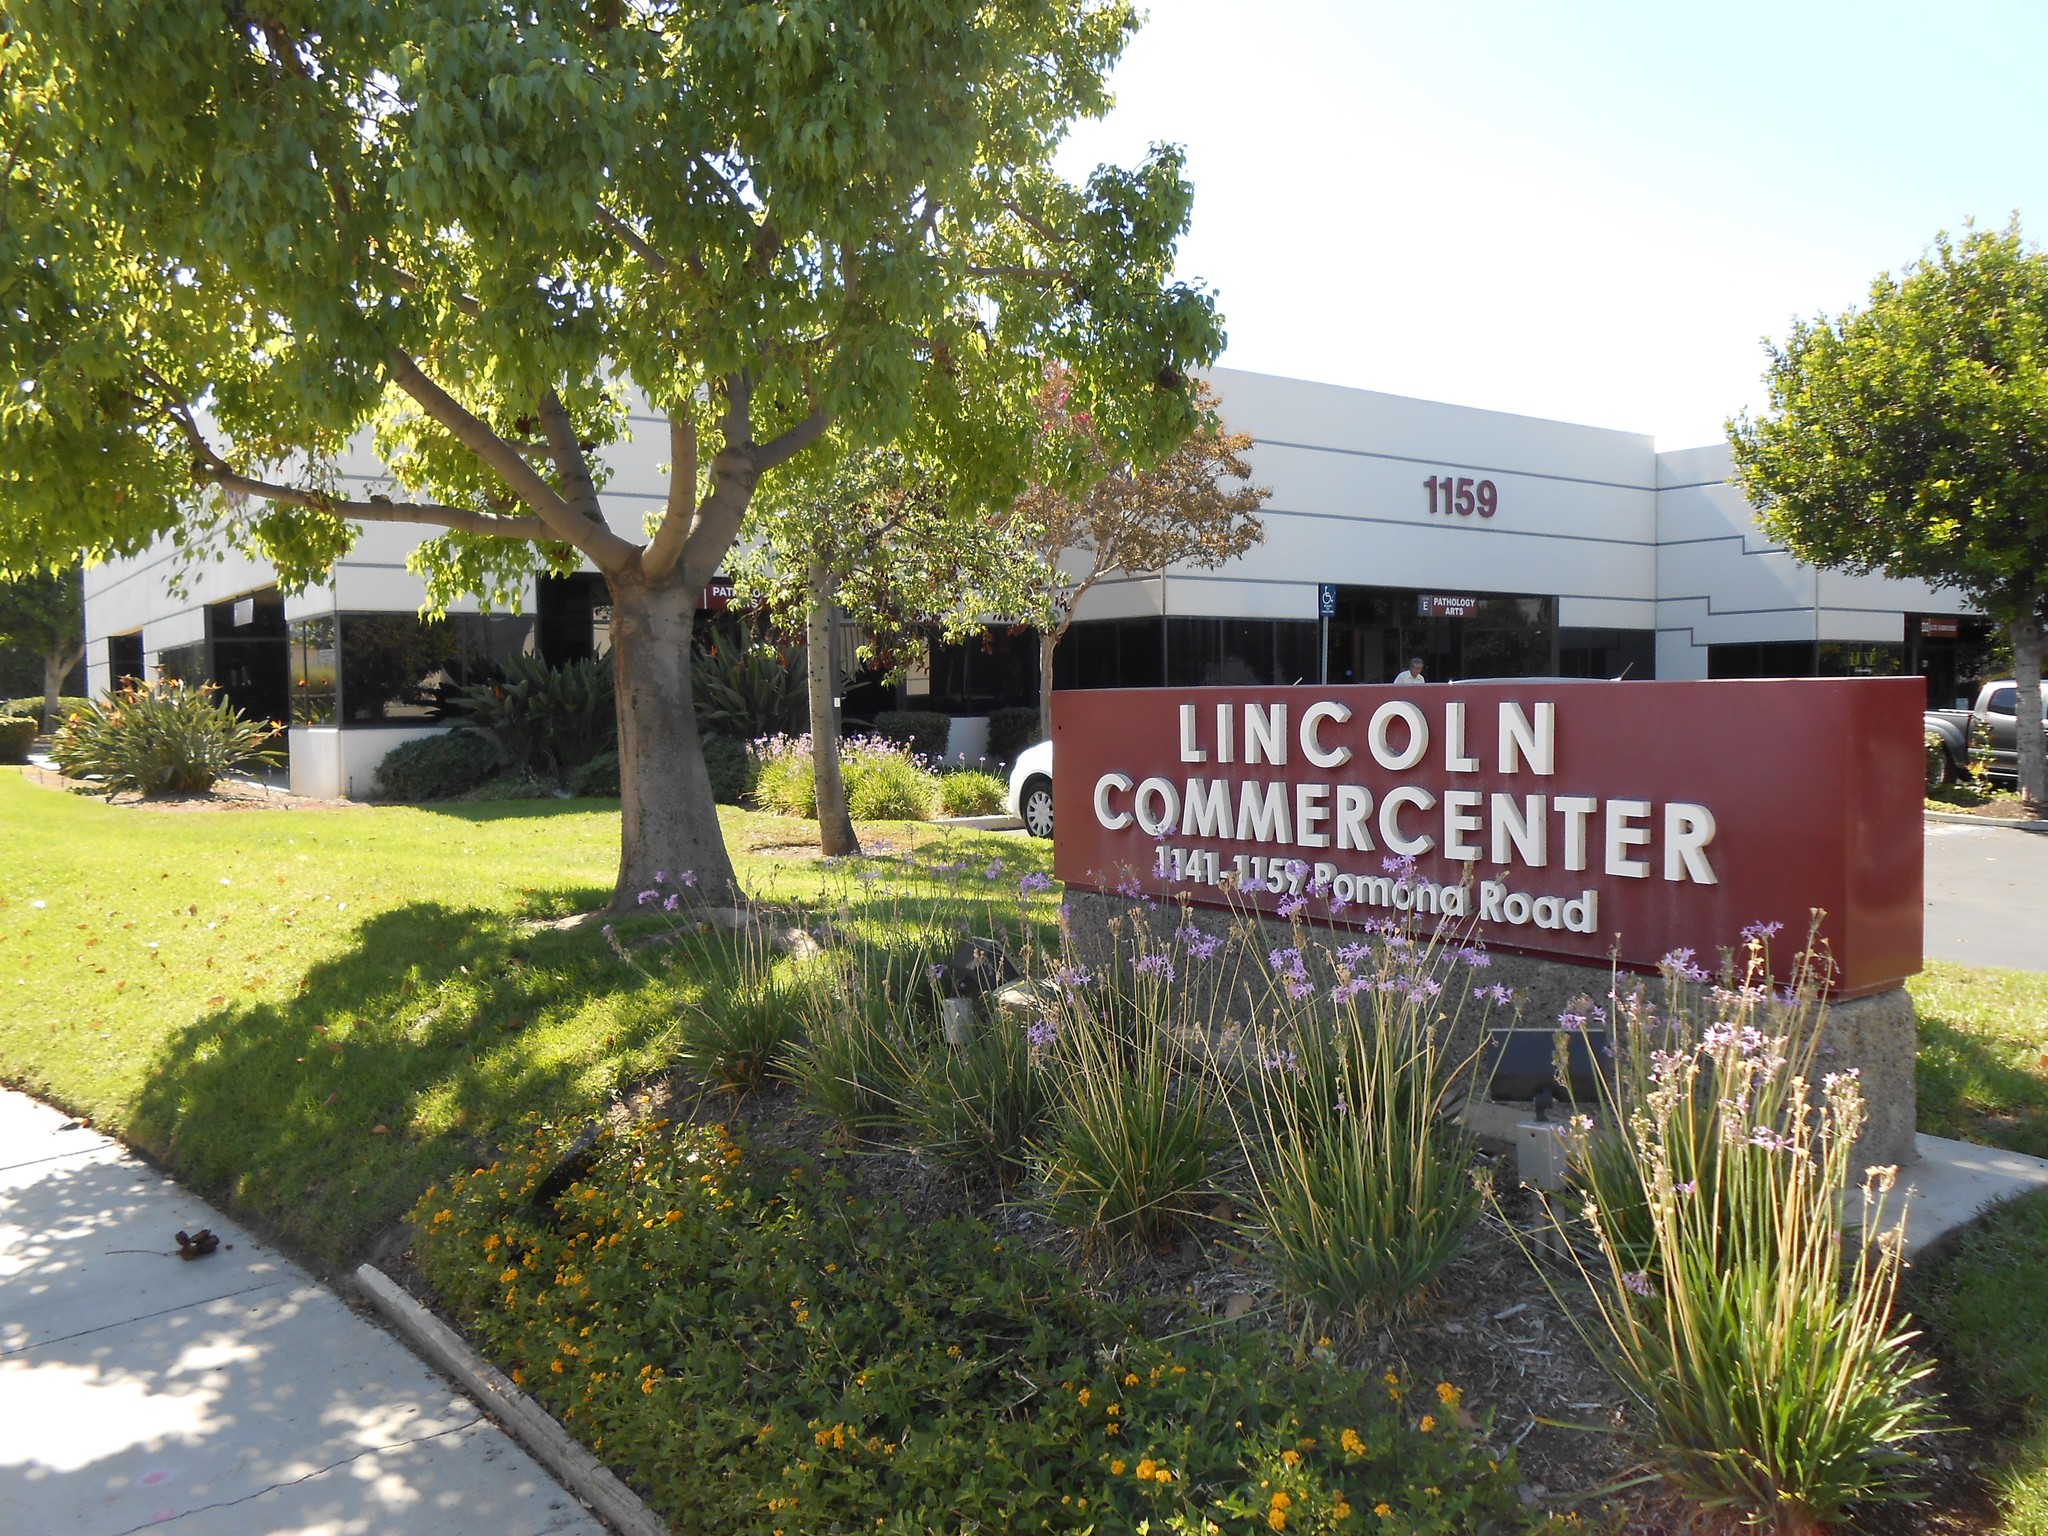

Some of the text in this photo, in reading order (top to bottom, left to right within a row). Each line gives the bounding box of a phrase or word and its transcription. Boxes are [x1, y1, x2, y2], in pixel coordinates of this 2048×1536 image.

[1422, 475, 1498, 518] 1159
[1423, 601, 1429, 611] E
[1433, 597, 1475, 607] PATHOLOGY
[1445, 607, 1464, 616] ARTS
[1179, 701, 1555, 775] LINCOLN
[1093, 772, 1718, 884] COMMERCENTER
[1155, 844, 1599, 933] 1141-1159 Pomona Road
